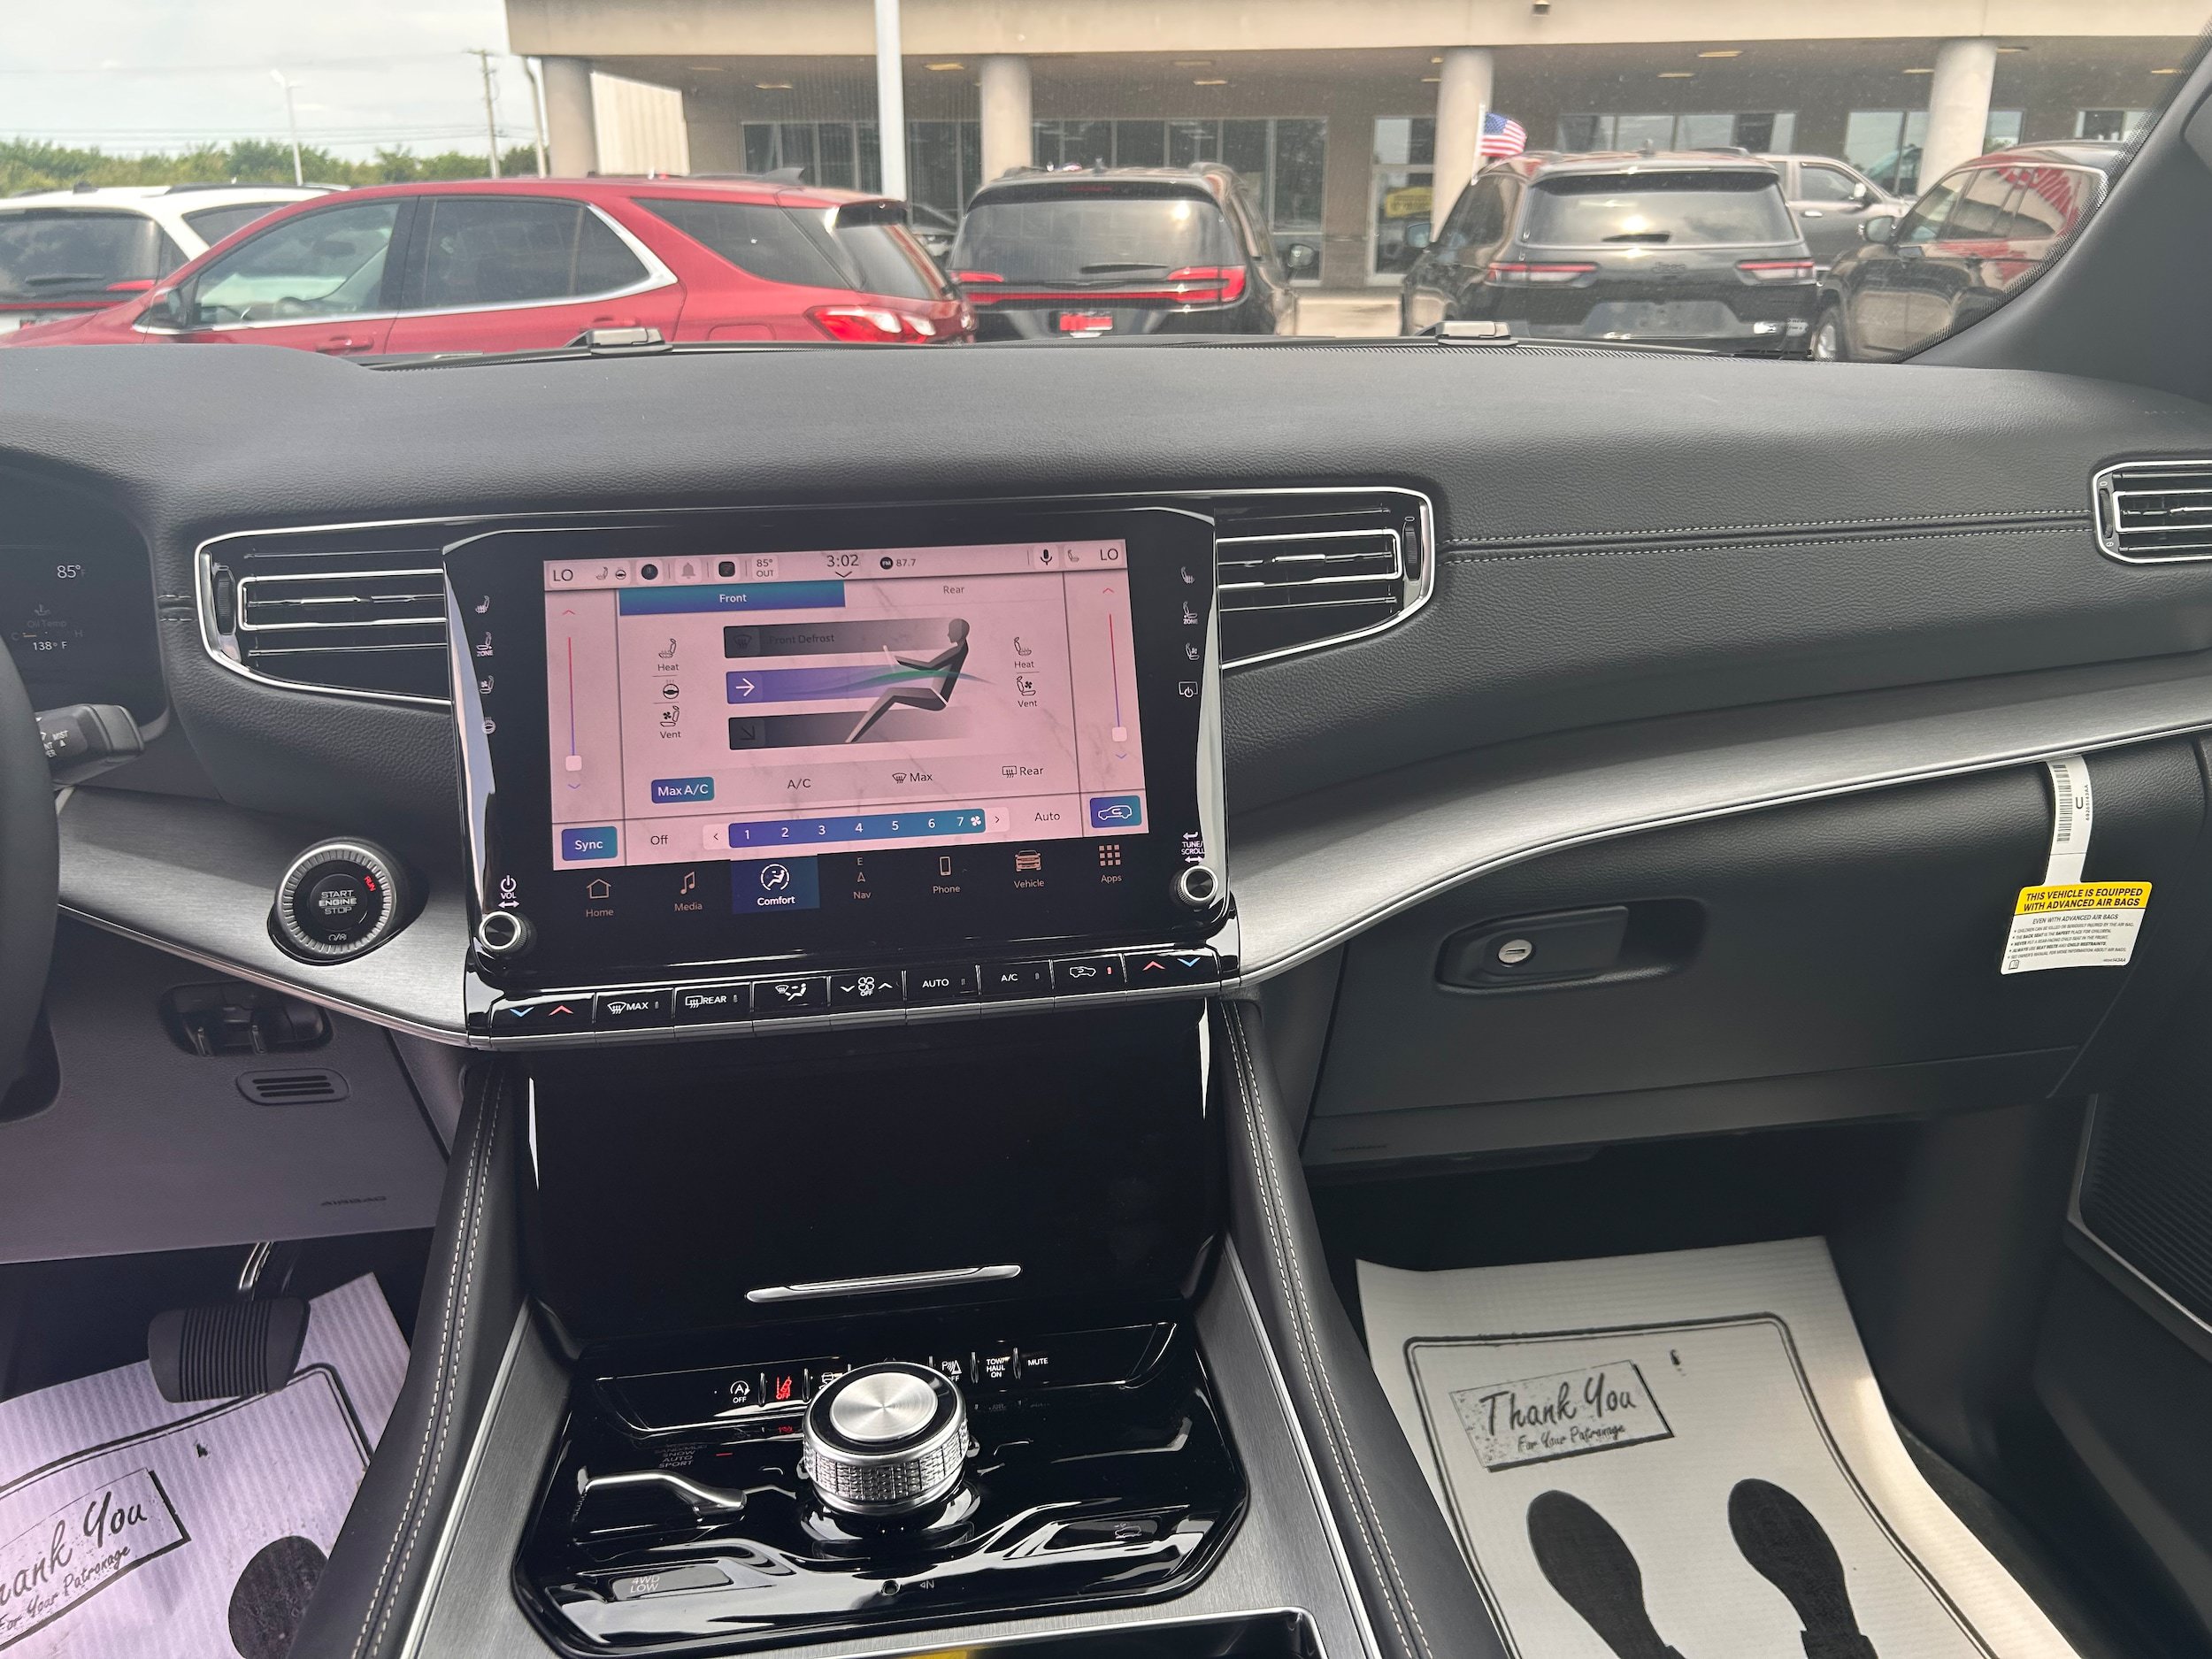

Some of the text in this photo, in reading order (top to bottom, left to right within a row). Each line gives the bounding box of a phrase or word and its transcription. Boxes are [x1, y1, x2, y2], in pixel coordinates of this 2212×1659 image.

[1100, 548, 1118, 561] LO
[757, 558, 773, 568] 85°
[826, 554, 859, 567] 3:02
[553, 569, 573, 582] LO
[942, 586, 964, 595] Rear
[719, 594, 747, 603] Front
[768, 633, 835, 645] Front Defrost
[61, 641, 68, 650] F
[1014, 660, 1034, 669] Heat
[660, 731, 681, 740] Vent
[1020, 766, 1043, 776] Rear
[910, 772, 933, 783] Max
[658, 783, 709, 797] Max A/C
[787, 779, 811, 790] A/C
[2076, 796, 2084, 809] U
[1034, 811, 1061, 822] Auto
[744, 817, 964, 840] 1 2 3 4 5 6 7
[574, 839, 603, 852] Sync
[650, 834, 669, 846] Off
[857, 857, 864, 866] E
[364, 875, 376, 892] RUN
[1013, 877, 1044, 889] Vehicle
[1101, 873, 1122, 884] Apps
[321, 889, 354, 899] START
[853, 890, 872, 900] Nav
[932, 884, 961, 895] Phone
[2026, 887, 2143, 902] THIS VEHICLE IS EQUIPPED
[319, 897, 357, 907] ENGINE
[757, 895, 796, 906] Comfort
[2024, 902, 2045, 912] WITH
[2047, 900, 2093, 910] ADVANCED
[2114, 898, 2139, 907] BAGS
[674, 901, 703, 912] Media
[586, 908, 614, 918] Home
[1001, 972, 1018, 982] A/C
[922, 978, 949, 988] AUTO
[703, 995, 726, 1004] REAR
[626, 1001, 649, 1011] MAX
[1027, 1357, 1048, 1366] MUTE
[1479, 1372, 1637, 1435] Thank You
[1517, 1434, 1538, 1453] For
[1540, 1430, 1567, 1448] Your
[658, 1460, 694, 1469] SPORT
[0, 1491, 148, 1606] ank You
[632, 1575, 660, 1585] 4WD
[630, 1583, 659, 1594] LOW
